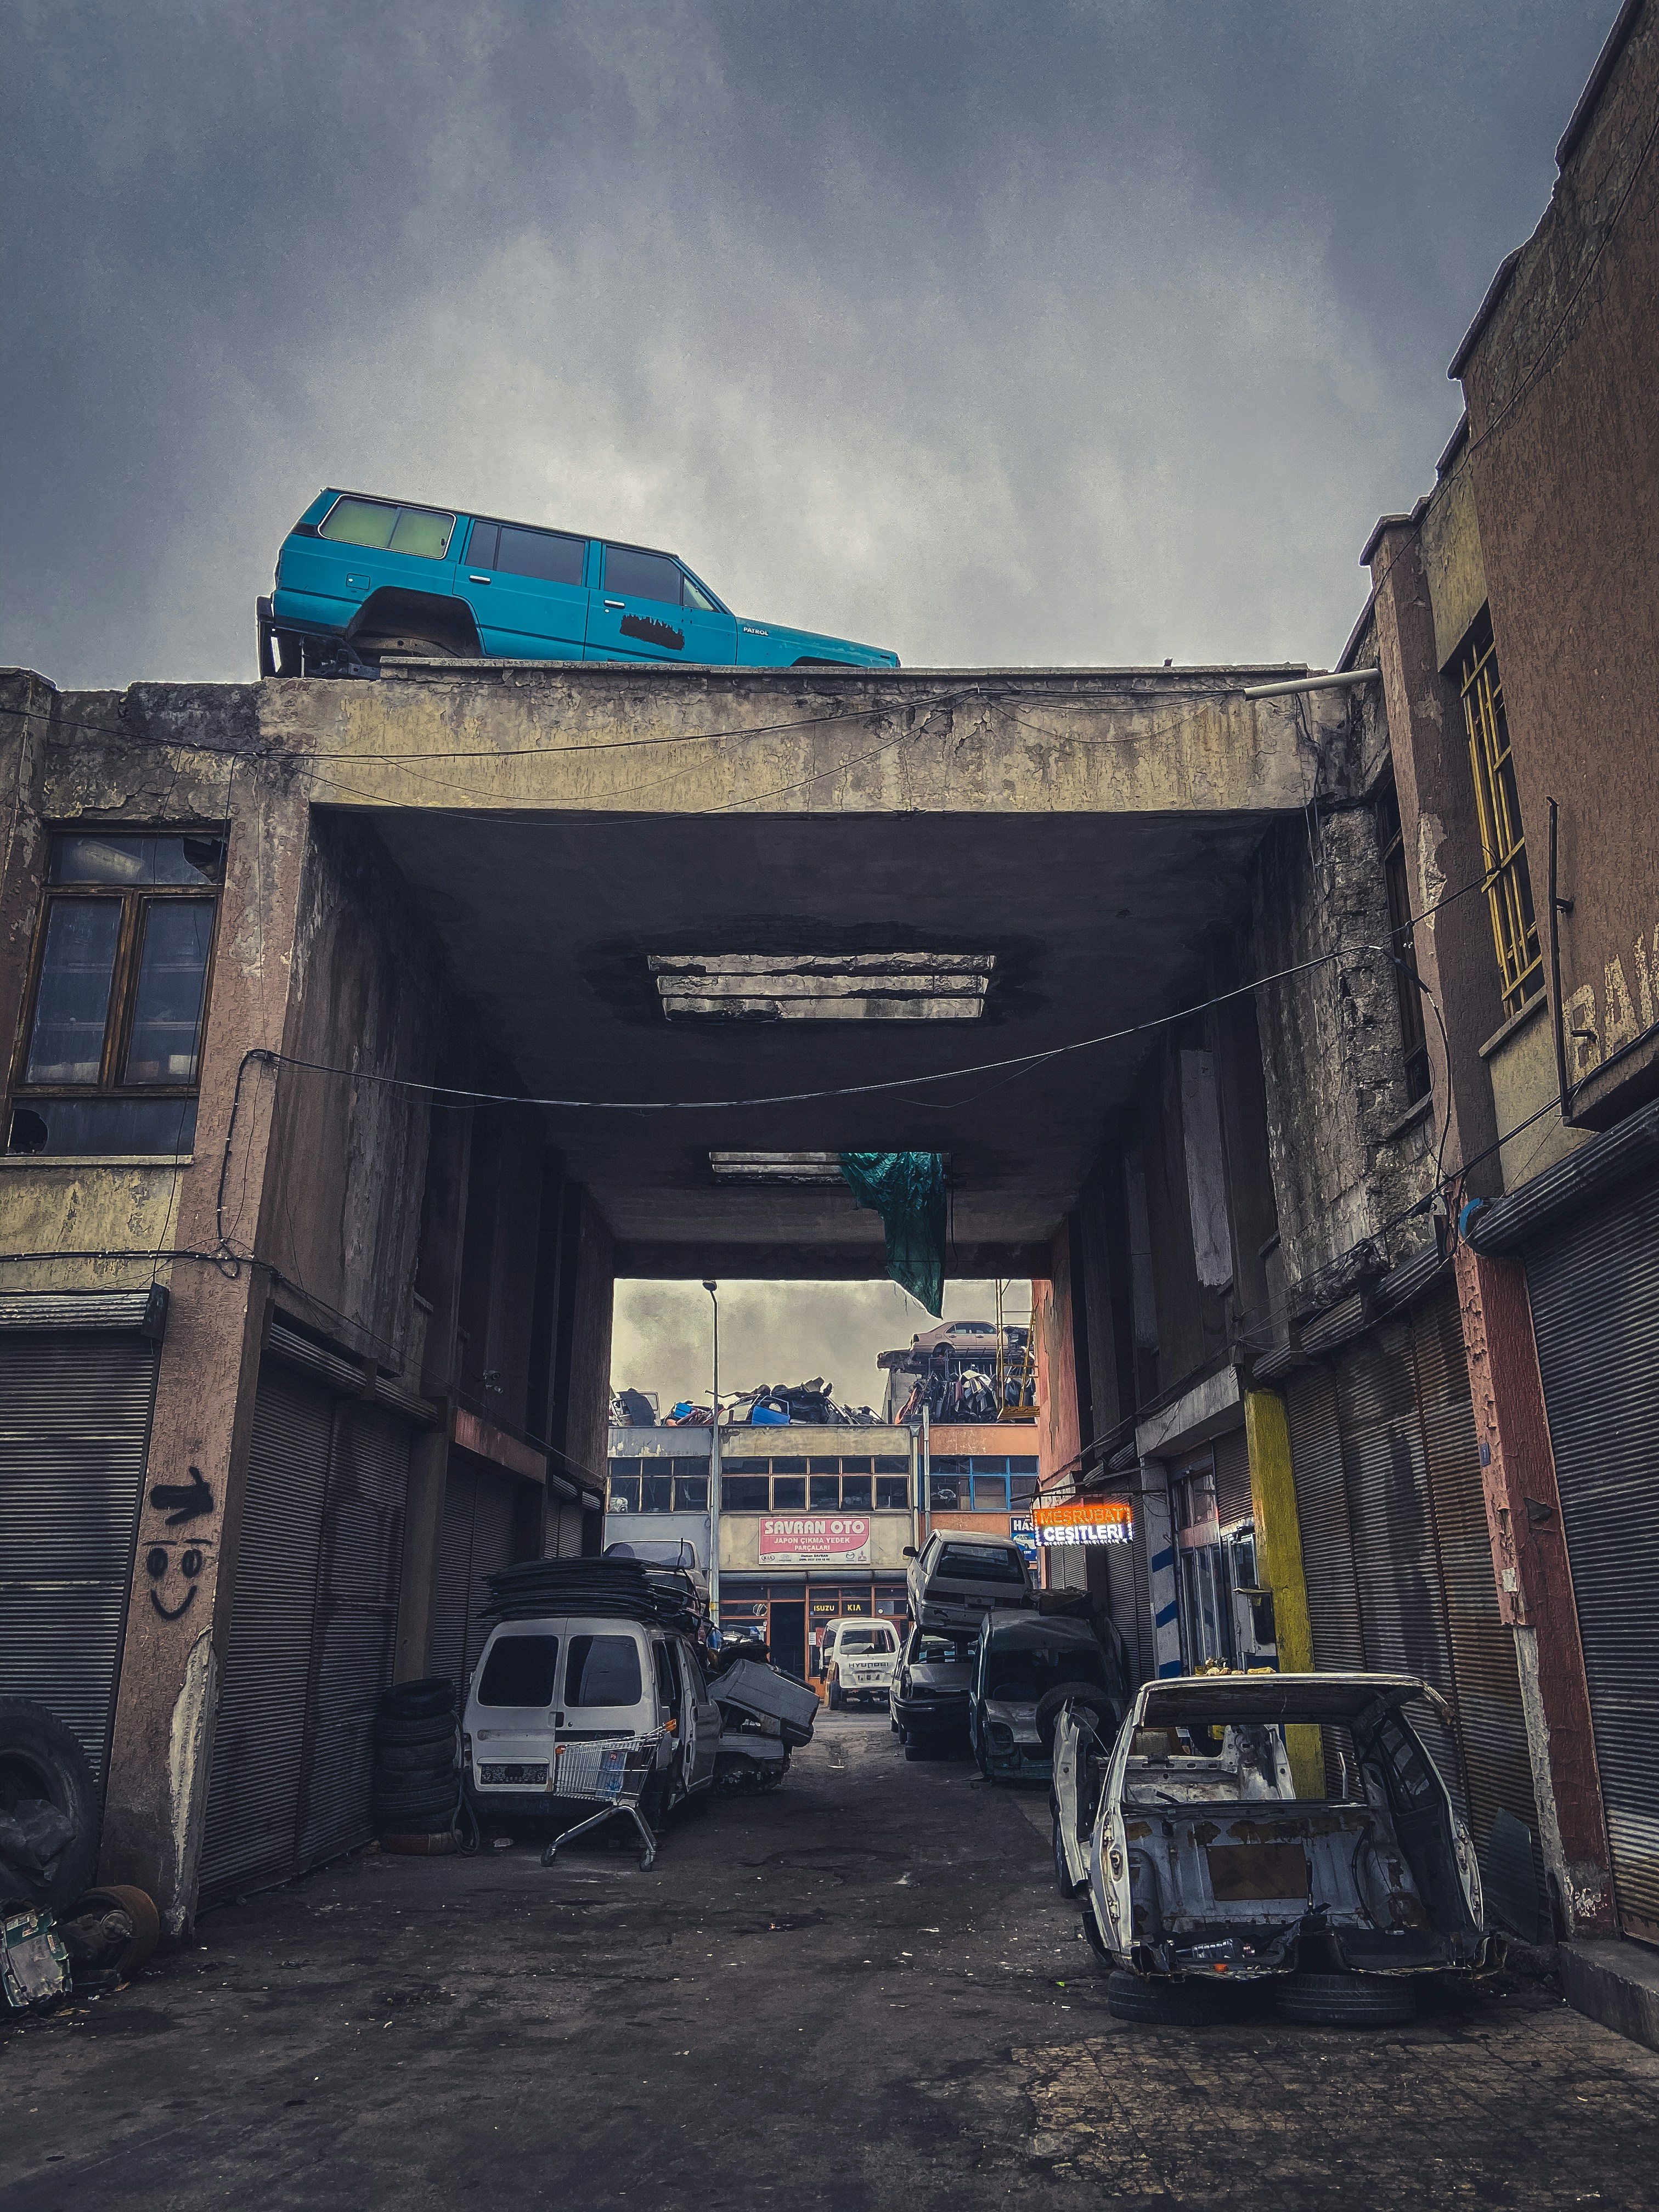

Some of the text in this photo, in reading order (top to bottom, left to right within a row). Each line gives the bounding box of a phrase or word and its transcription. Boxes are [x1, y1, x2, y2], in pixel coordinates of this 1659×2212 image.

[743, 627, 769, 636] PATROL
[764, 1520, 865, 1534] SAVRAN OTO
